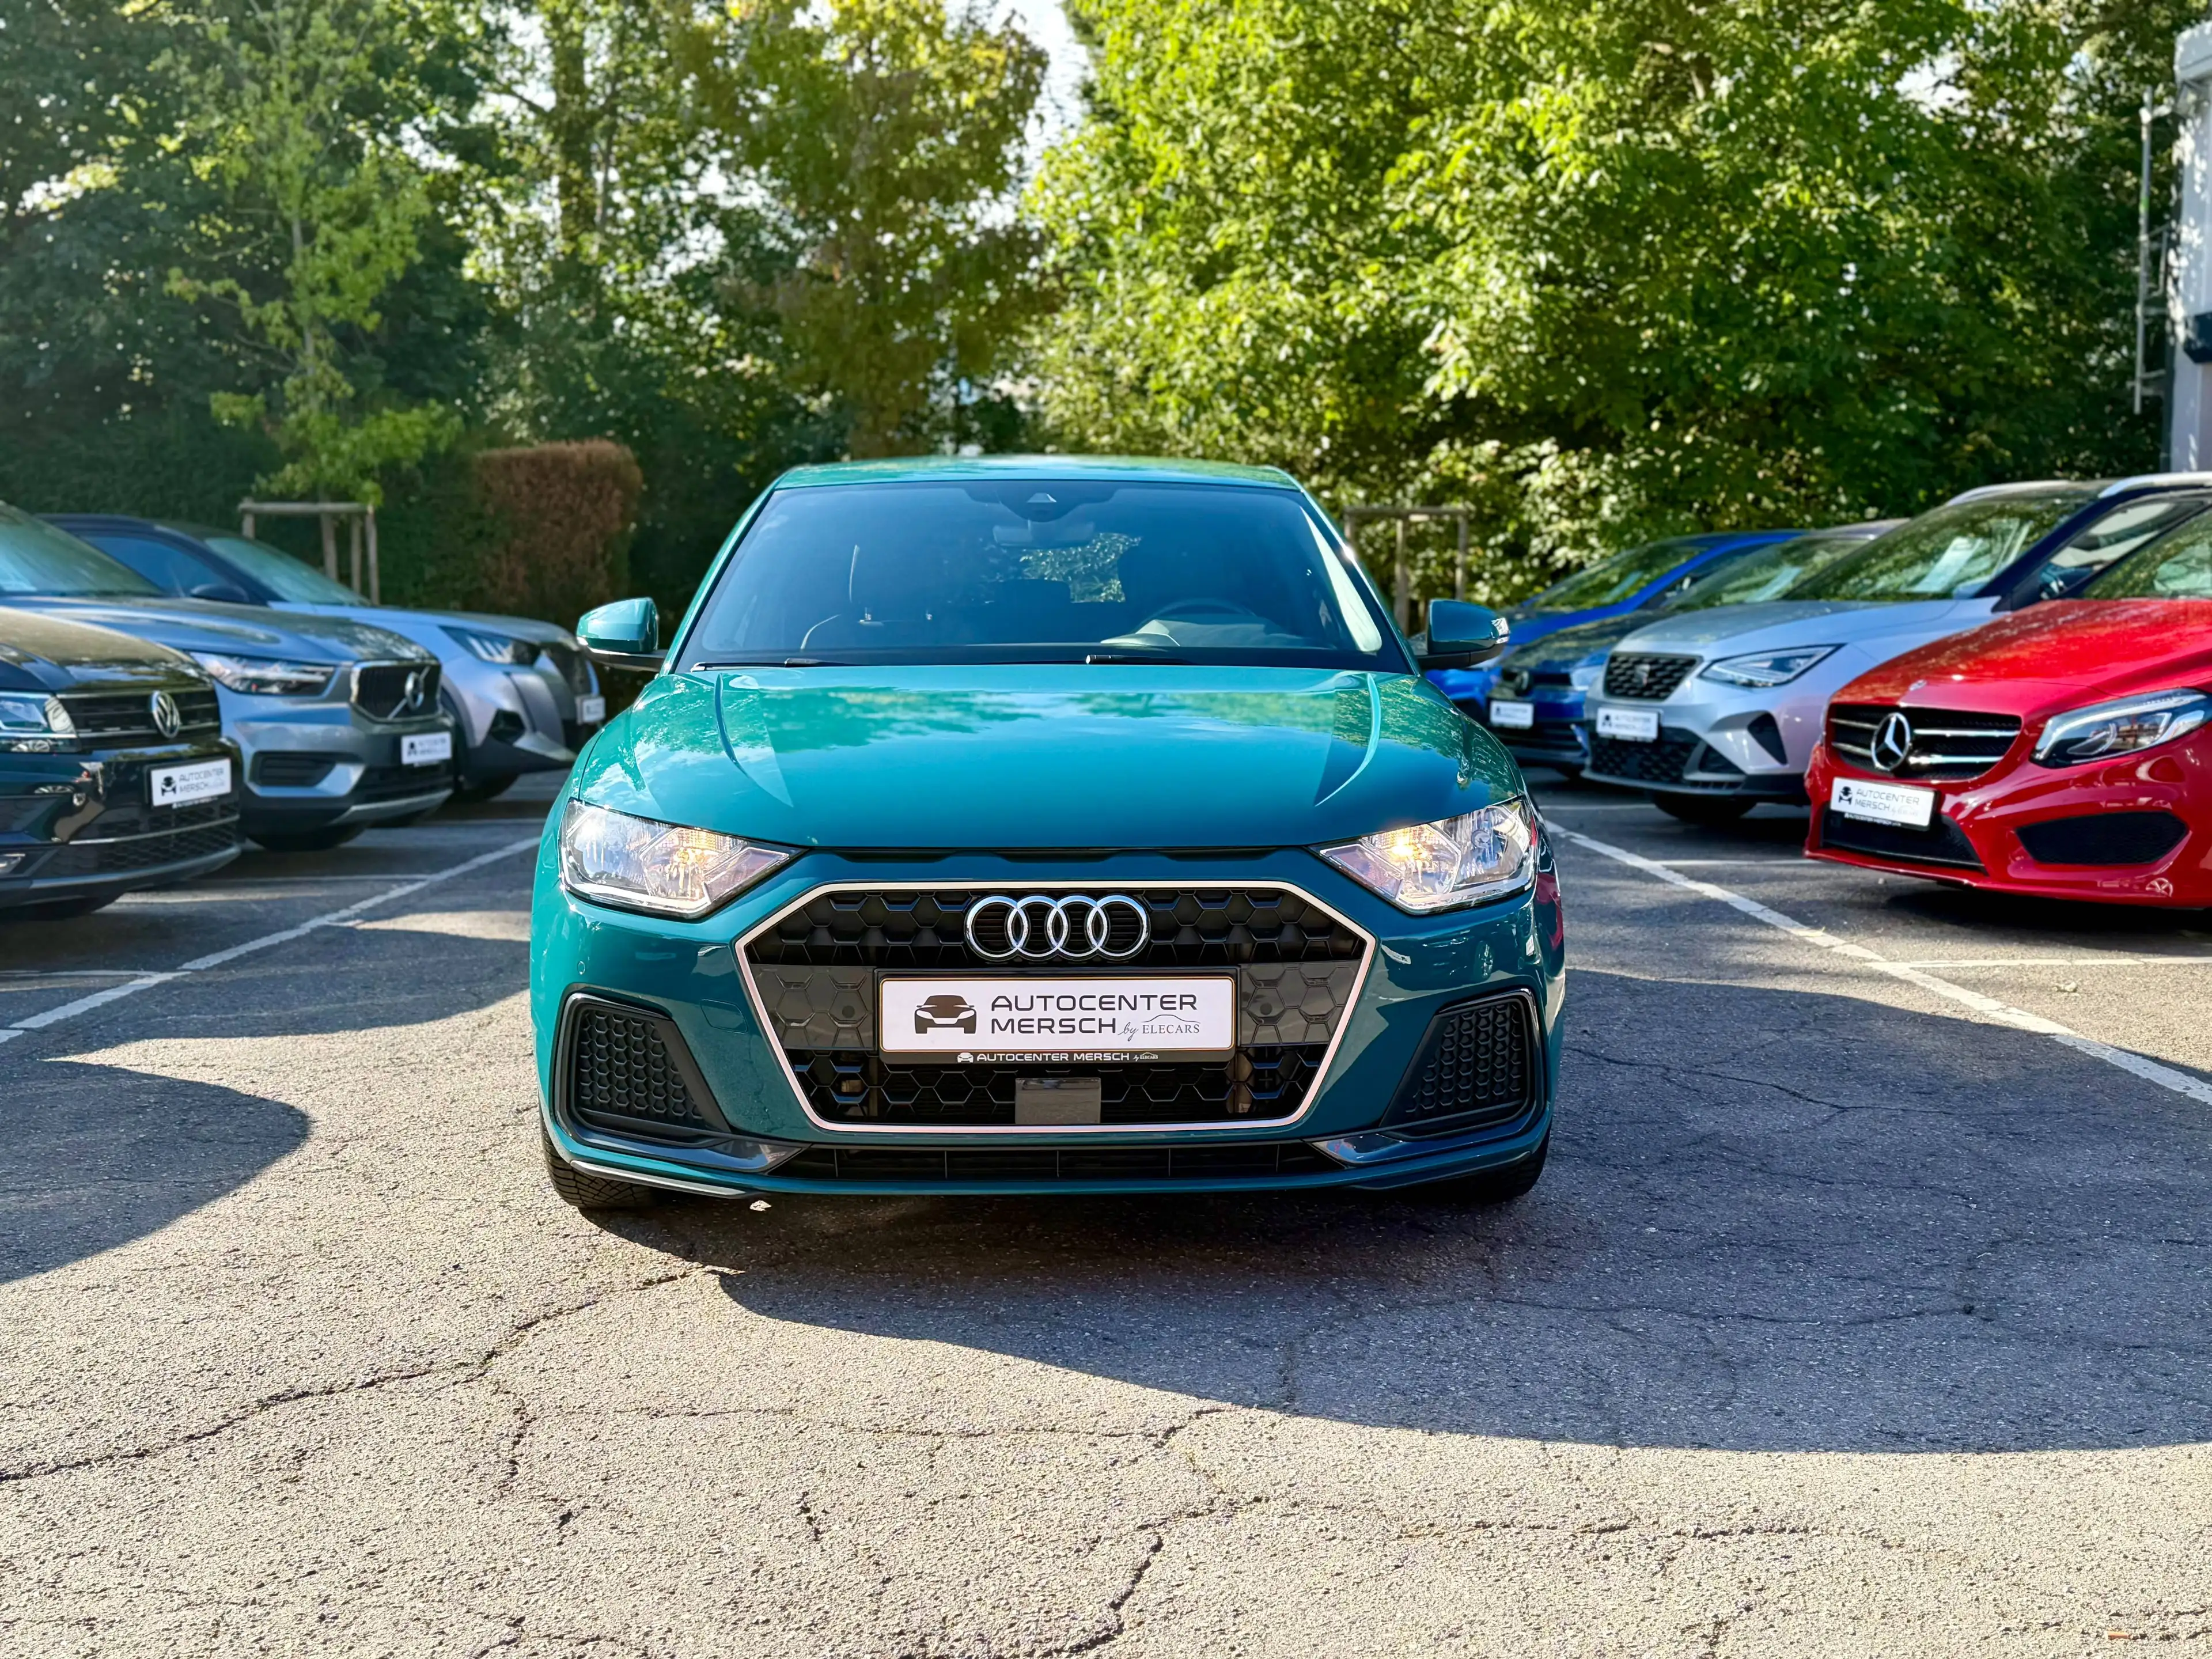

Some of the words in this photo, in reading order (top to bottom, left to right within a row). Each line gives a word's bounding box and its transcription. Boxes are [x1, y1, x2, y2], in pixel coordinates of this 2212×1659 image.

[1855, 798, 1890, 811] MERSCH
[1857, 789, 1919, 805] AUTOCENTER
[991, 994, 1198, 1012] AUTOCENTER
[991, 1018, 1116, 1034] MERSCH
[1118, 1022, 1139, 1041] by
[1142, 1024, 1200, 1034] ELECARS
[977, 1053, 1069, 1061] AUTOCENTER
[1073, 1052, 1130, 1060] MERSCH
